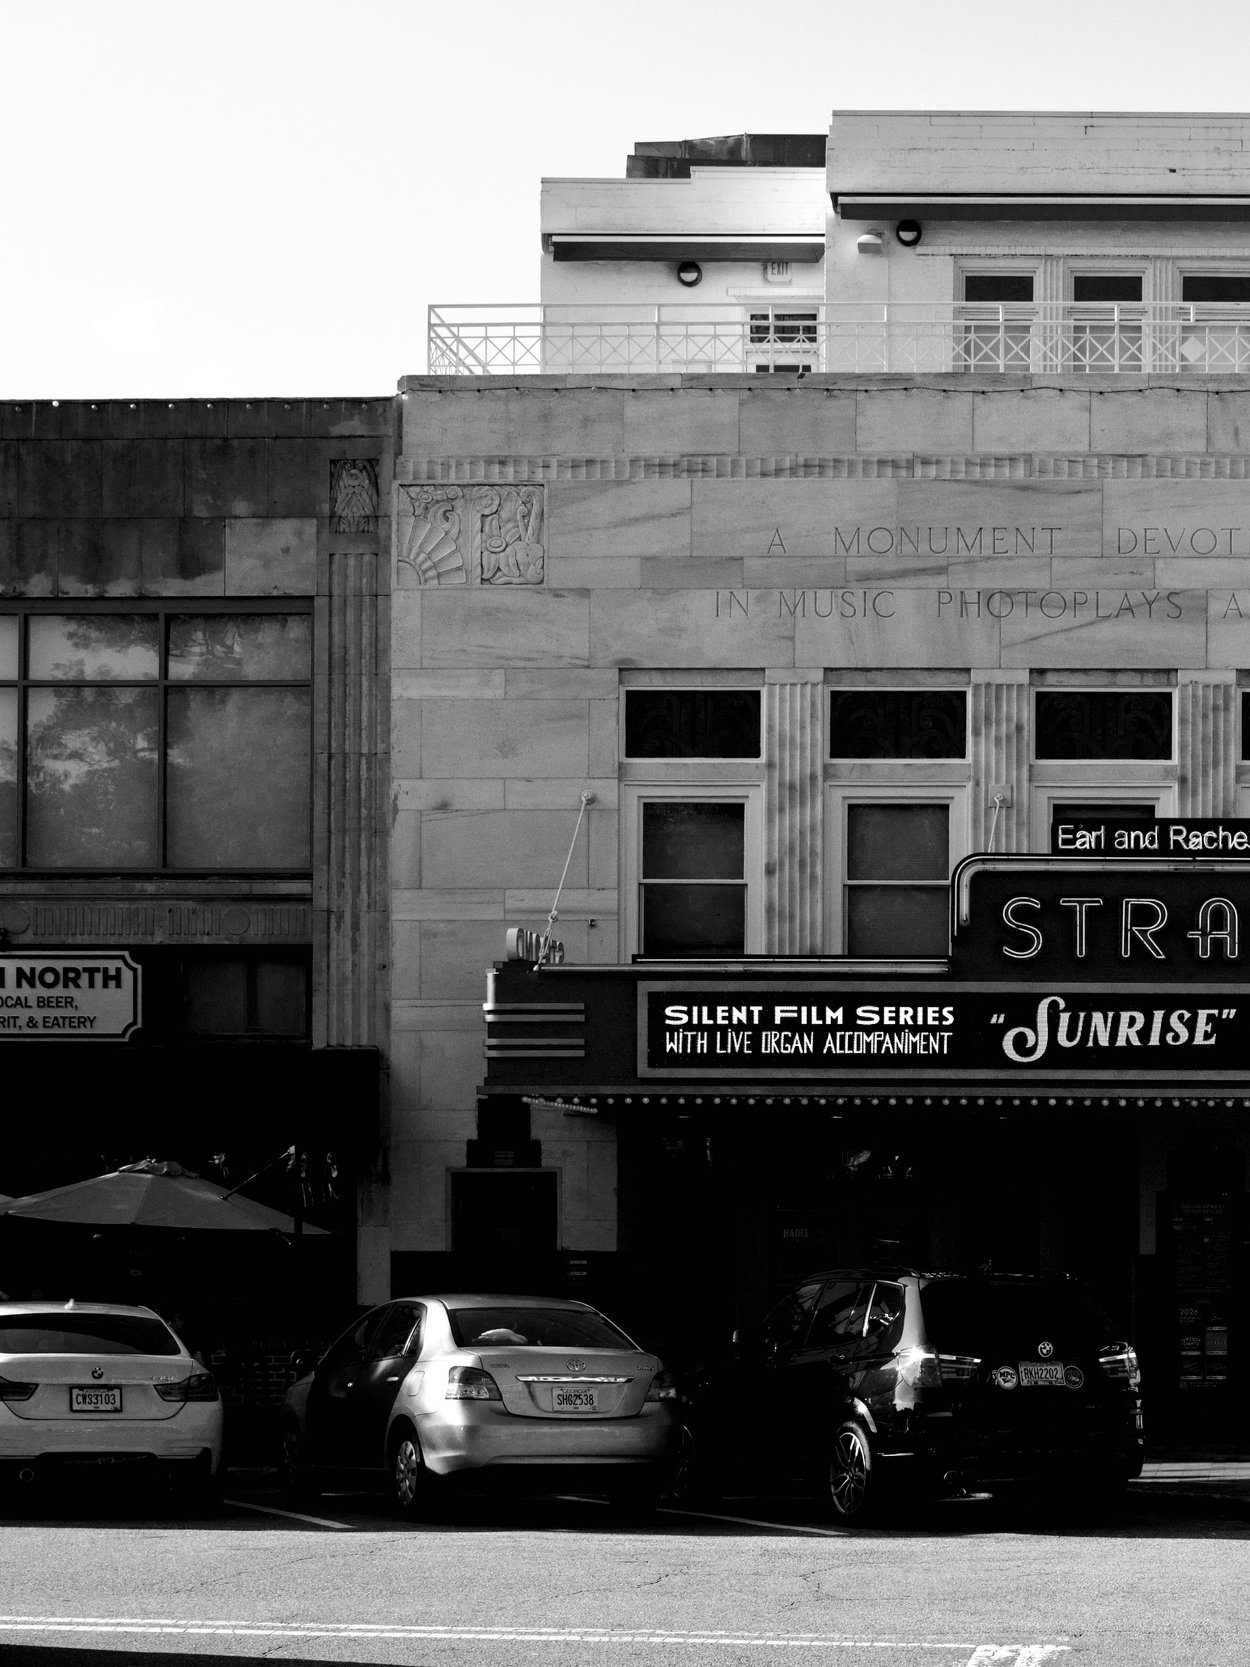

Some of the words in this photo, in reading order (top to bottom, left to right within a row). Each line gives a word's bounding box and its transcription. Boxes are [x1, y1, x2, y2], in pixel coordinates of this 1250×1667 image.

[770, 260, 789, 276] EXIT
[767, 527, 787, 555] A
[833, 527, 1062, 556] MONUMENT
[715, 590, 751, 618] IN
[778, 590, 896, 619] MUSIC
[936, 590, 1184, 620] PHOTOPLAYS
[1058, 824, 1105, 850] Earl
[1114, 825, 1159, 850] and
[16, 966, 122, 989] NORTH
[36, 996, 79, 1011] BEER,
[26, 1016, 38, 1029] &
[42, 1016, 97, 1029] EATERY
[664, 1005, 763, 1025] SILENT
[774, 1005, 844, 1025] FILM
[855, 1005, 955, 1026] SERIES
[761, 1030, 814, 1054] ORGAN
[1024, 1367, 1059, 1380] RKH2202
[75, 1393, 116, 1406] CWS3103
[556, 1393, 595, 1406] SHG2538
